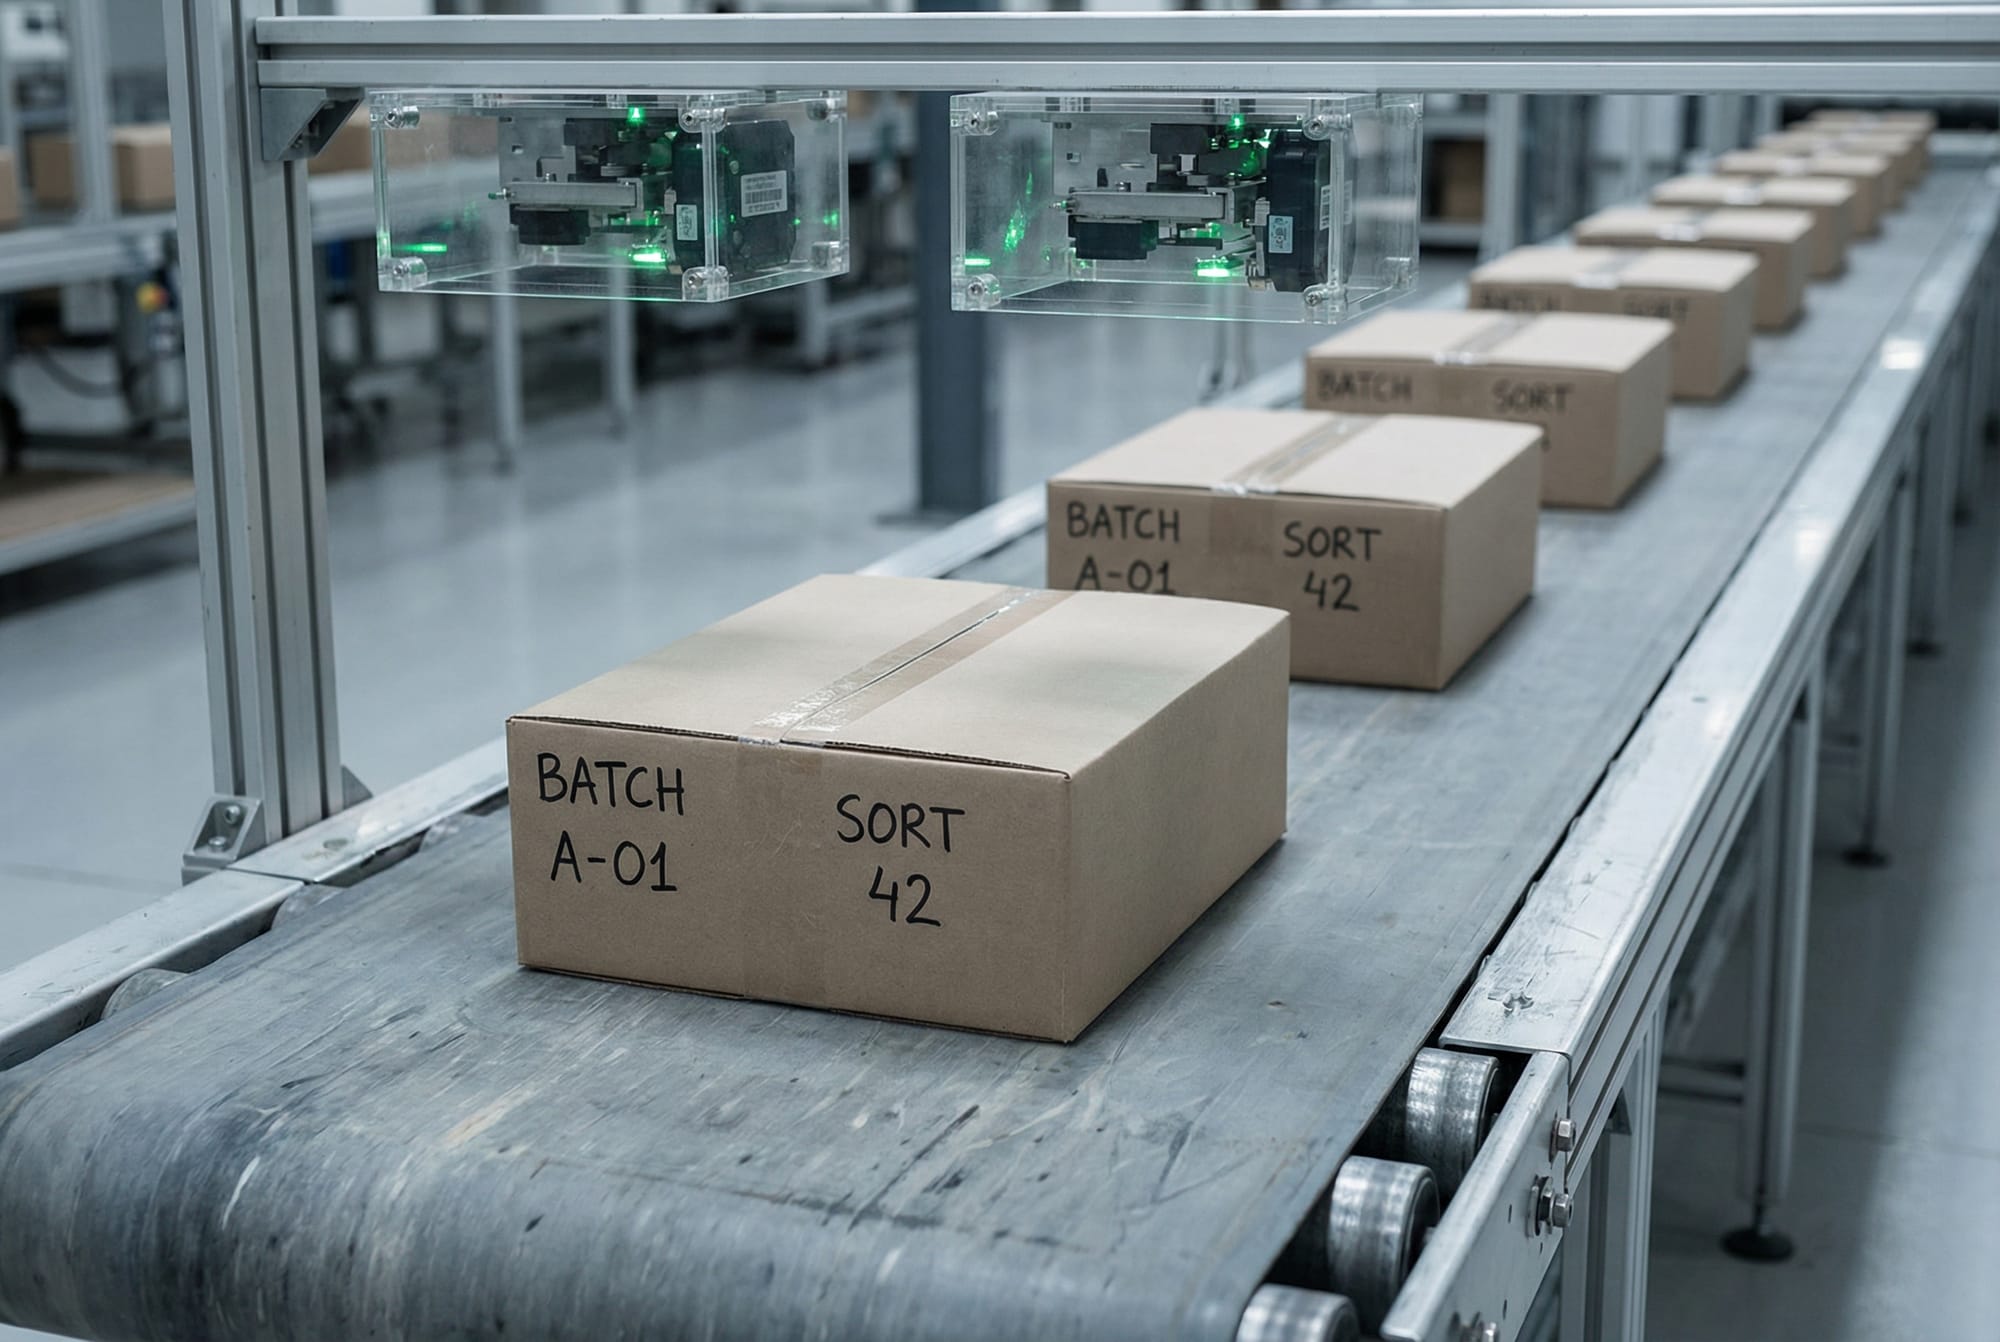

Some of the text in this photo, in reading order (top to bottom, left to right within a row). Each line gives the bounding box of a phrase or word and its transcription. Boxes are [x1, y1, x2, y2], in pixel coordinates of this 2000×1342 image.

[1317, 368, 1413, 401] BATCH
[1492, 379, 1573, 414] SORT
[1067, 501, 1180, 543] BATCH
[1283, 521, 1382, 562] SORT
[1076, 557, 1176, 595] A-01
[1303, 570, 1360, 612] 42
[537, 752, 685, 816] BATCH
[836, 793, 965, 853] SORT
[550, 831, 678, 892] A-01
[868, 866, 941, 927] 42
